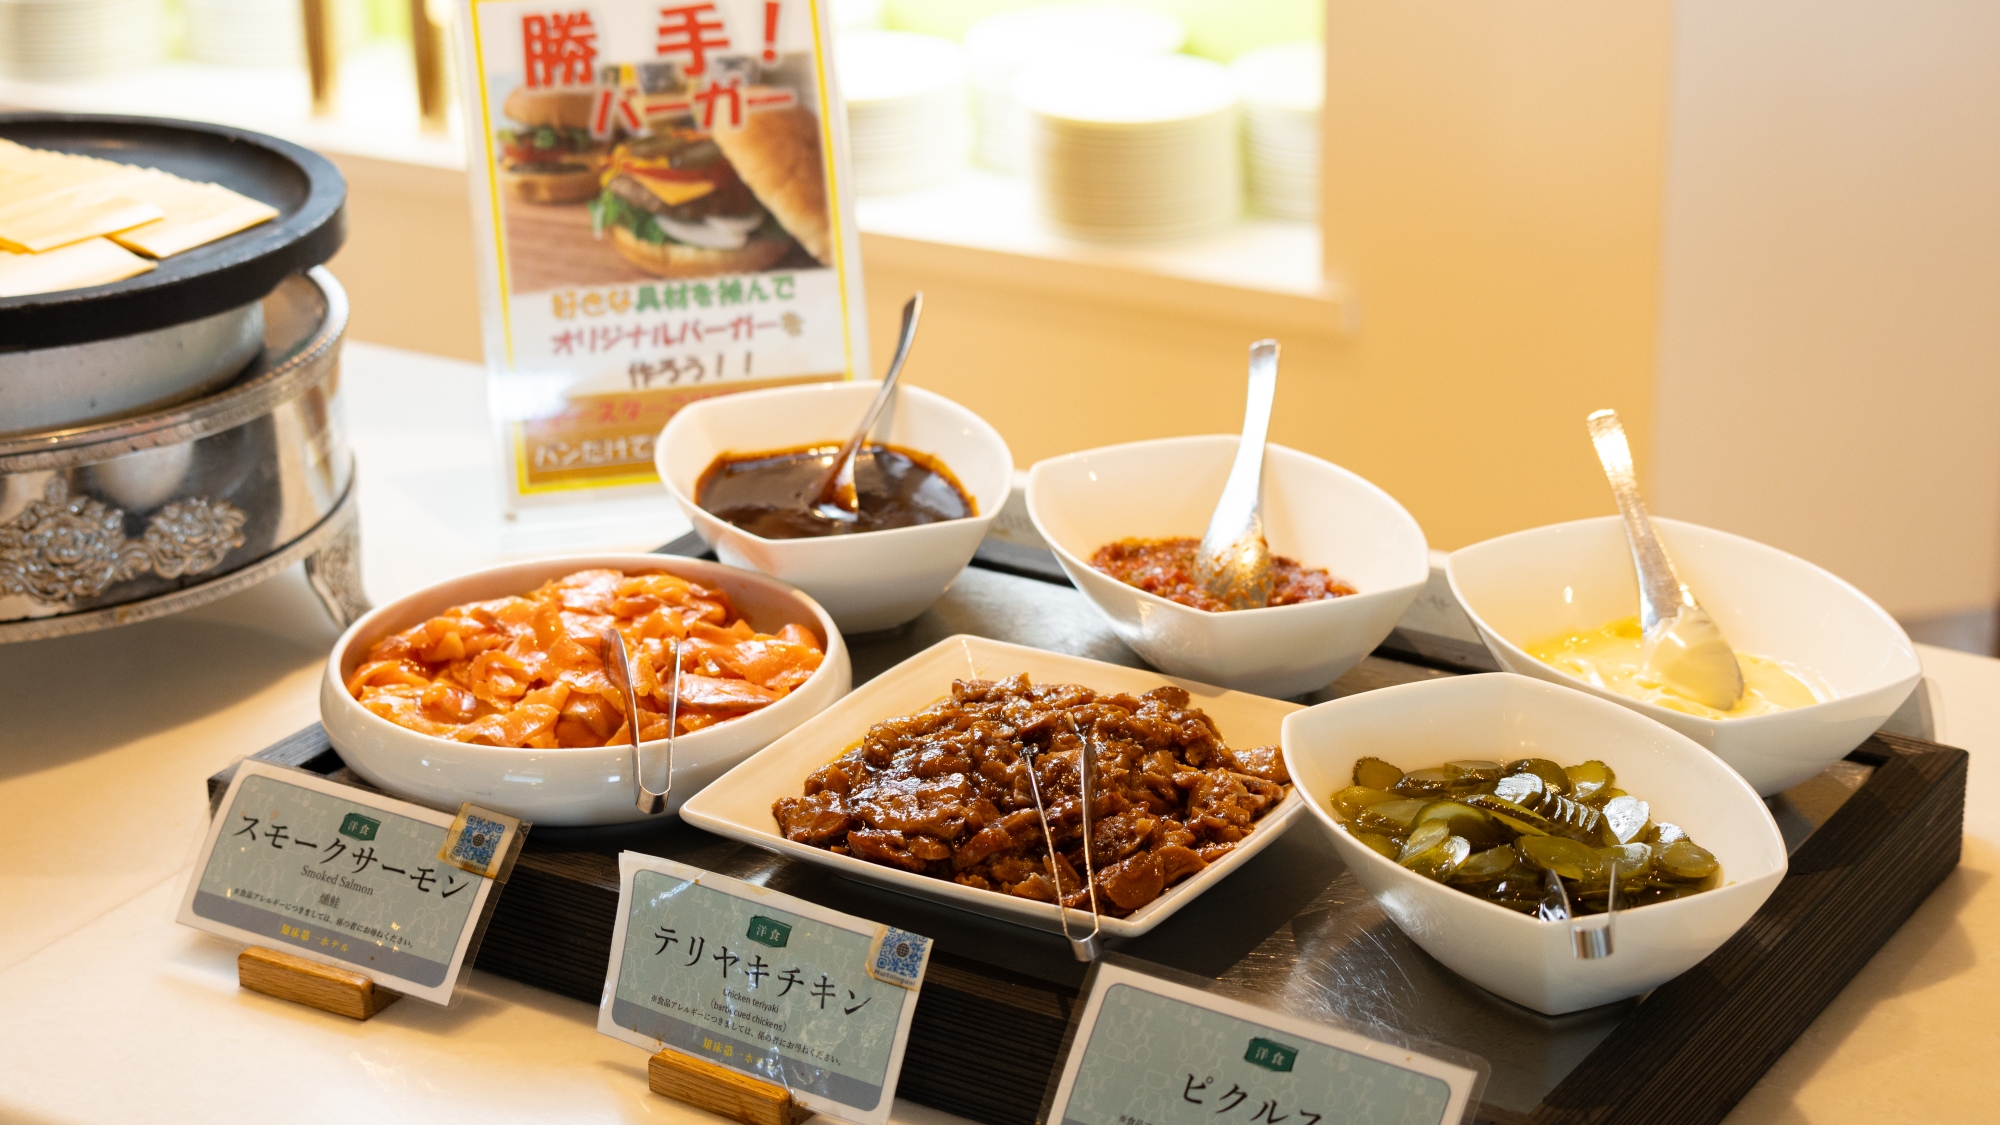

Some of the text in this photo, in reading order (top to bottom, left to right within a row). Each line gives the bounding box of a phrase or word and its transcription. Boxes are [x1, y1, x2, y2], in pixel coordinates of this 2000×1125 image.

[594, 79, 793, 134] バーガー
[347, 820, 370, 836] 洋食
[233, 815, 470, 898] スモークサーモン
[301, 865, 375, 896] Smoked Salmon
[756, 924, 780, 942] 洋食
[654, 925, 872, 1016] テリヤキチキン
[874, 968, 916, 986] Multilingual
[752, 999, 780, 1014] teriyaki
[751, 1013, 787, 1033] chickens)
[1255, 1046, 1286, 1067] 洋食
